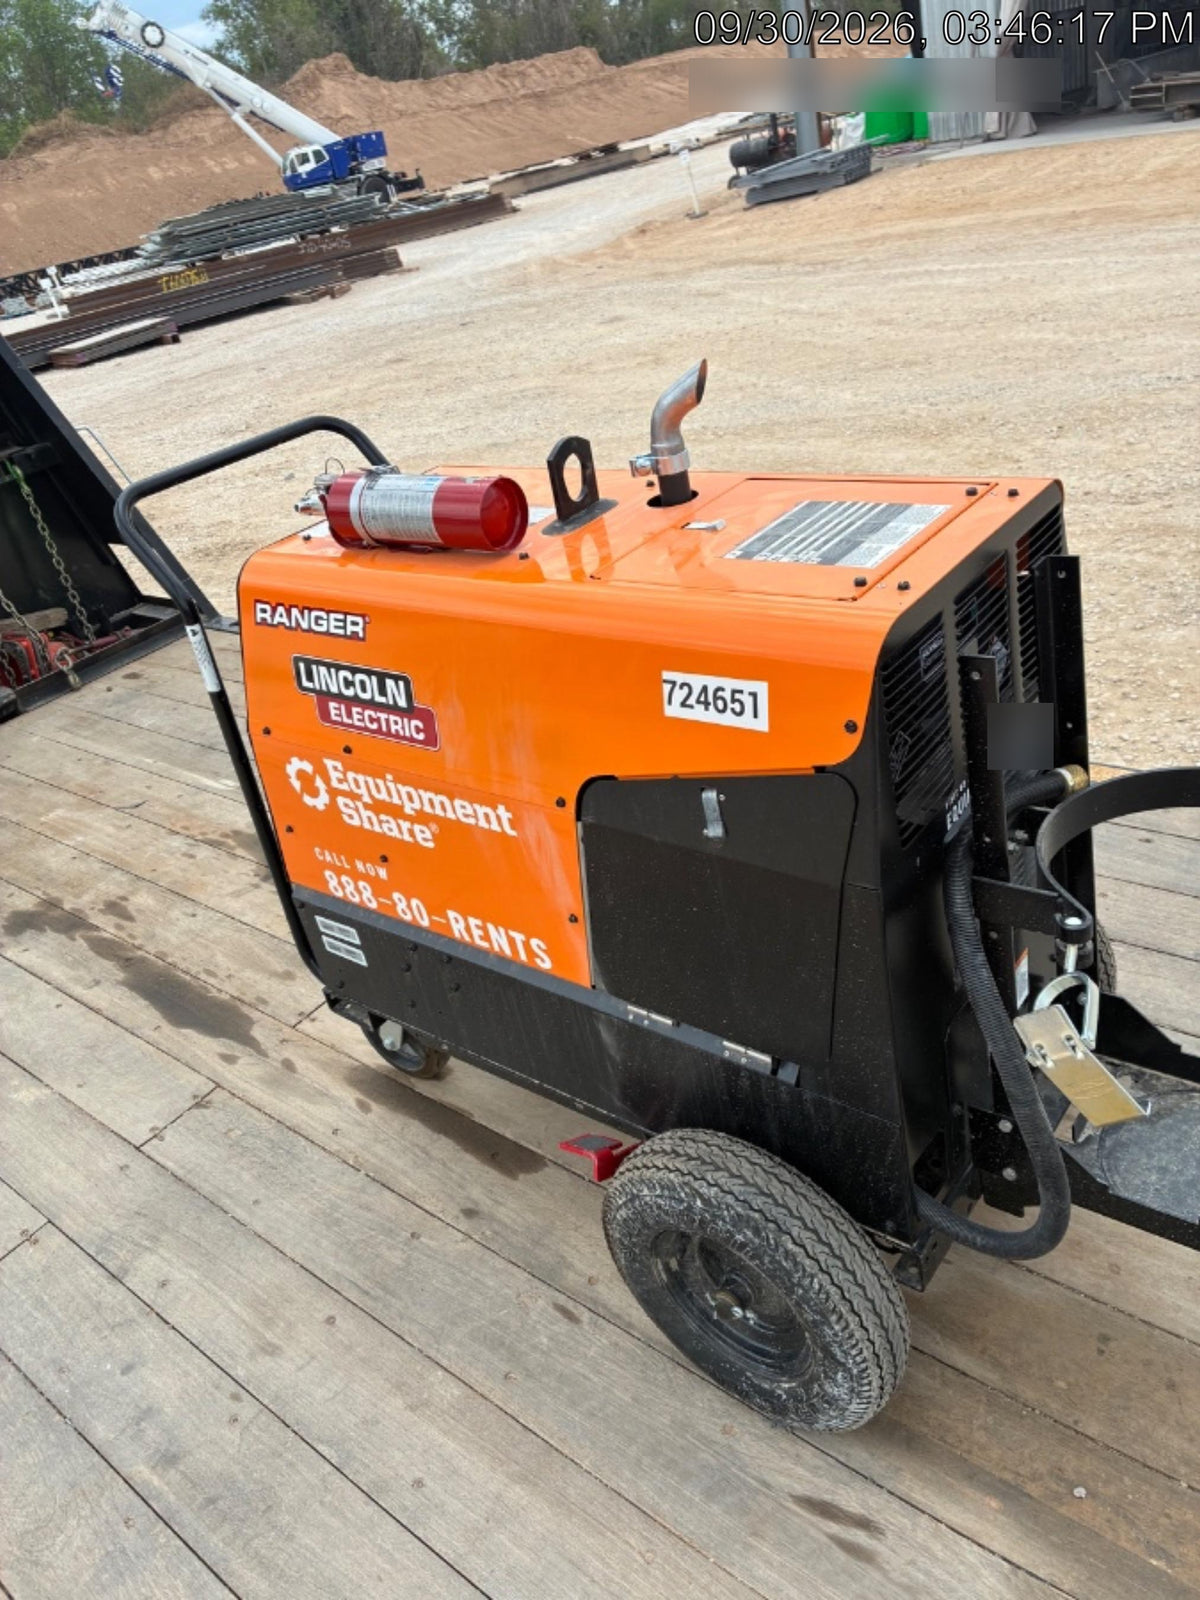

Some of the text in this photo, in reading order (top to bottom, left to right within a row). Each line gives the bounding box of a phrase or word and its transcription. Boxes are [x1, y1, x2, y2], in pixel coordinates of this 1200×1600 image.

[255, 602, 364, 638] RANGER
[298, 662, 408, 708] LINCOLN
[662, 679, 759, 719] 724651
[328, 701, 426, 741] ELECTRIC
[322, 758, 518, 836] Equipment
[336, 796, 435, 848] Share
[314, 847, 389, 880] CALL NOW
[323, 870, 552, 970] 888-80-RENTS
